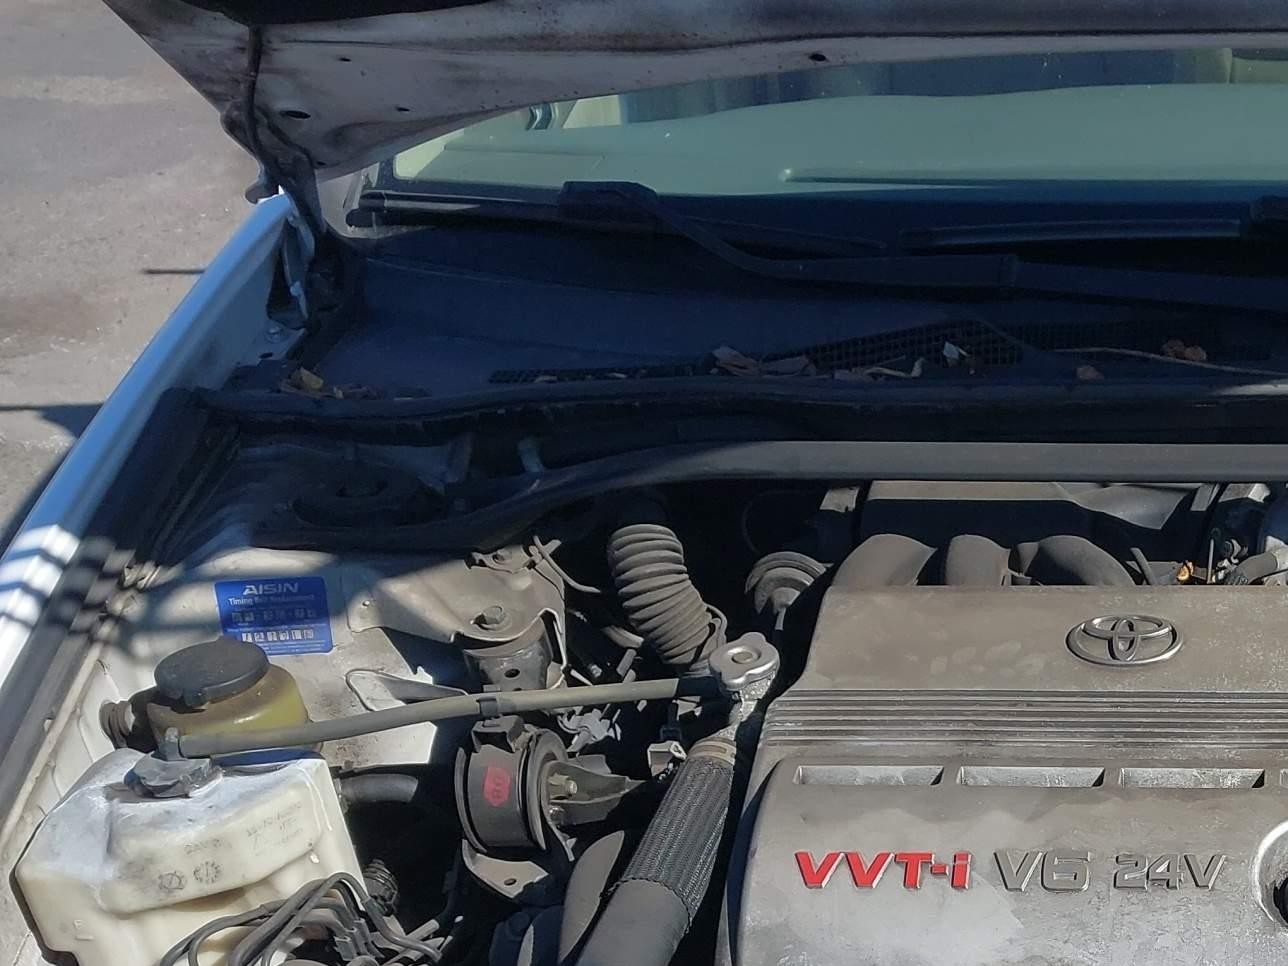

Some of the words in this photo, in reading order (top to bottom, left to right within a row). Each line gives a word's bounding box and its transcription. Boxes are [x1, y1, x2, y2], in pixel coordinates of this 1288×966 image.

[242, 582, 299, 596] AISIN
[228, 597, 254, 606] Timing
[795, 851, 973, 889] VVT-i
[993, 851, 1093, 892] V6
[1112, 853, 1227, 891] 24V
